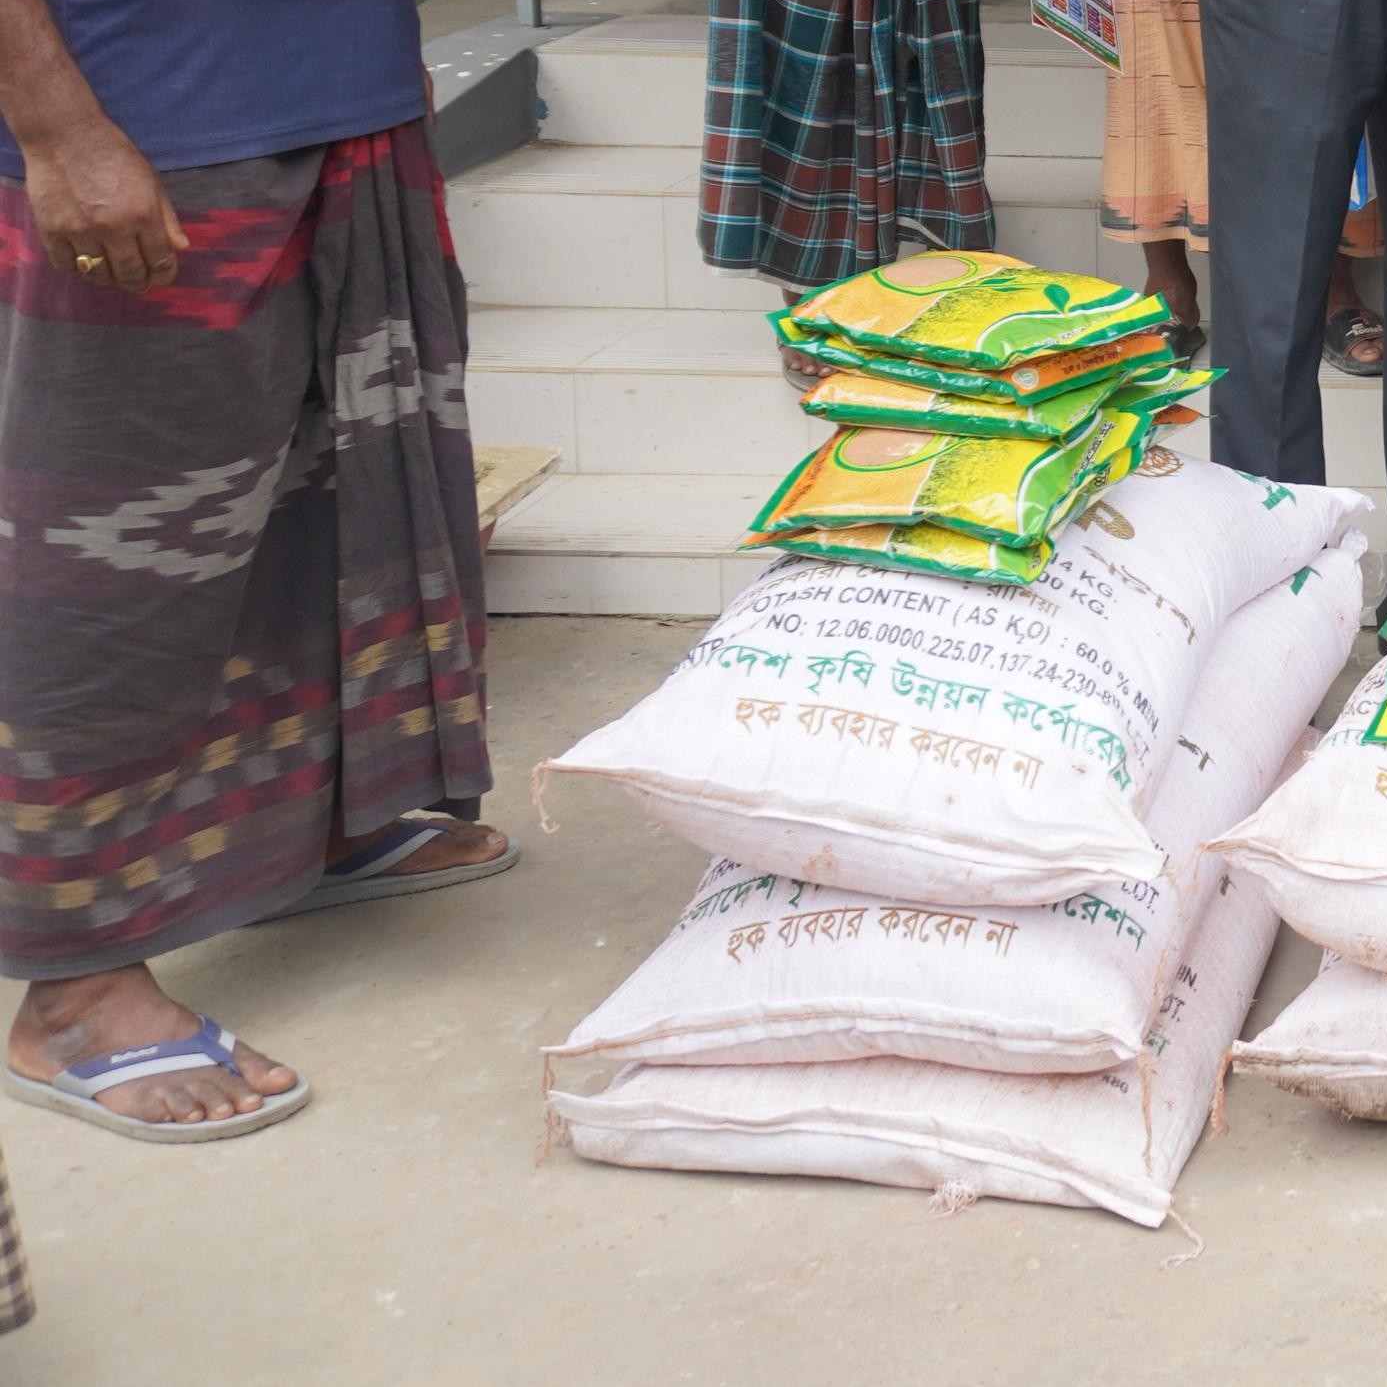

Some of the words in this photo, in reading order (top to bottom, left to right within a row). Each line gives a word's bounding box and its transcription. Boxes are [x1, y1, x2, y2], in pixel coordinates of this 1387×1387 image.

[750, 585, 834, 614] OTASH
[838, 585, 951, 618] CONTENT
[1074, 642, 1114, 677] 60.0
[765, 612, 808, 637] NO:
[806, 650, 877, 695] কৃষি
[890, 657, 991, 715] উন্নয়ন
[735, 696, 787, 735] হুক
[797, 702, 900, 747] ব্যবহার
[909, 725, 1006, 780] করবেন
[1013, 749, 1045, 790] না
[727, 920, 772, 964] হুক
[778, 905, 870, 949] ব্যবহার
[877, 905, 978, 947] করবেন
[985, 919, 1020, 958] না
